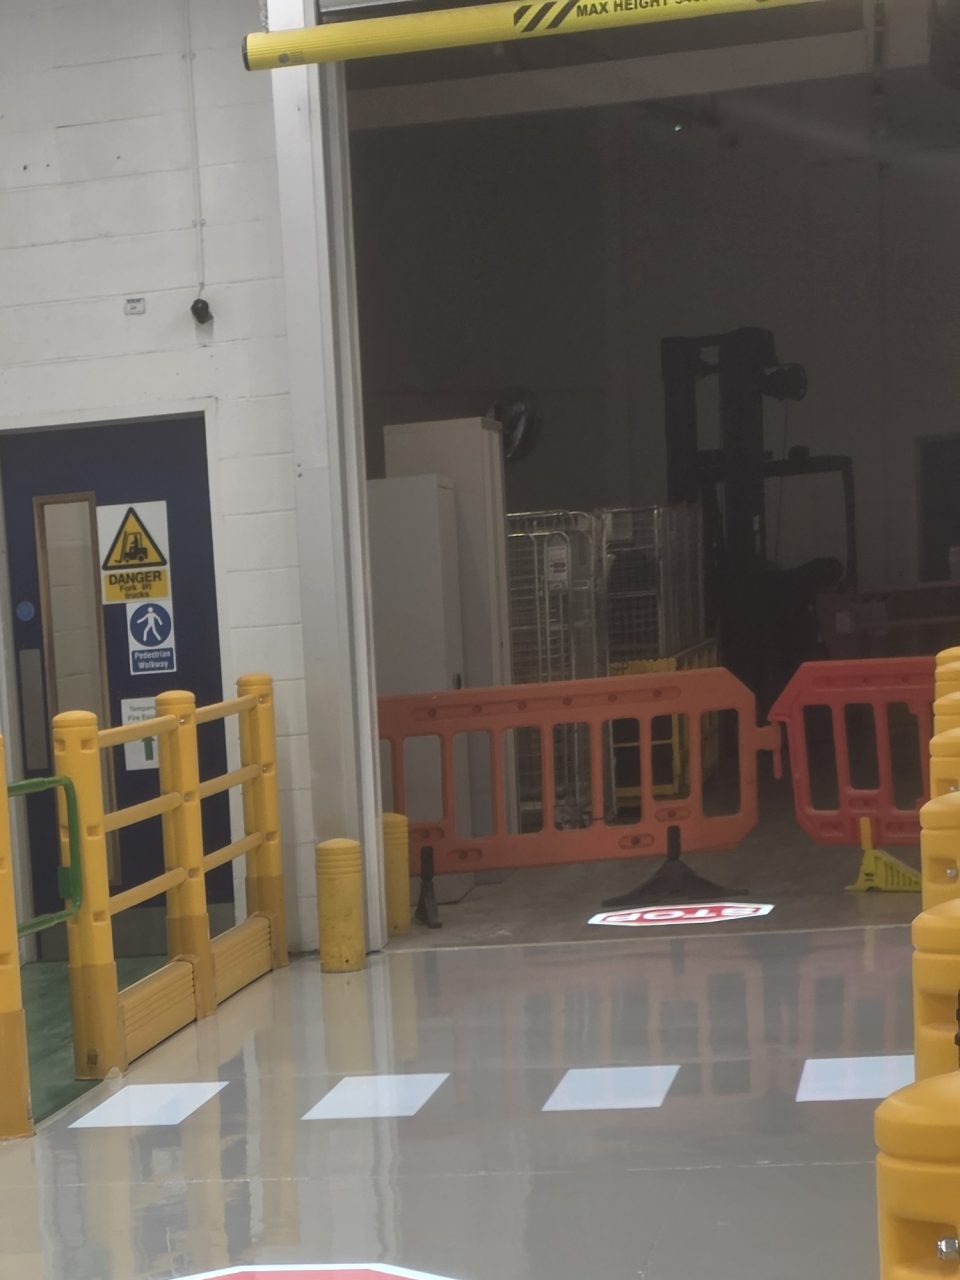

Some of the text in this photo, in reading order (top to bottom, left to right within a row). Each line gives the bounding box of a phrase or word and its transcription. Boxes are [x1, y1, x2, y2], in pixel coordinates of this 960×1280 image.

[576, 2, 609, 17] MAX
[108, 570, 162, 585] DANGER
[119, 584, 137, 592] Fork
[124, 590, 150, 599] trucks
[134, 650, 171, 660] Pedestrian
[137, 660, 169, 670] Walkway
[606, 907, 757, 922] STOP
